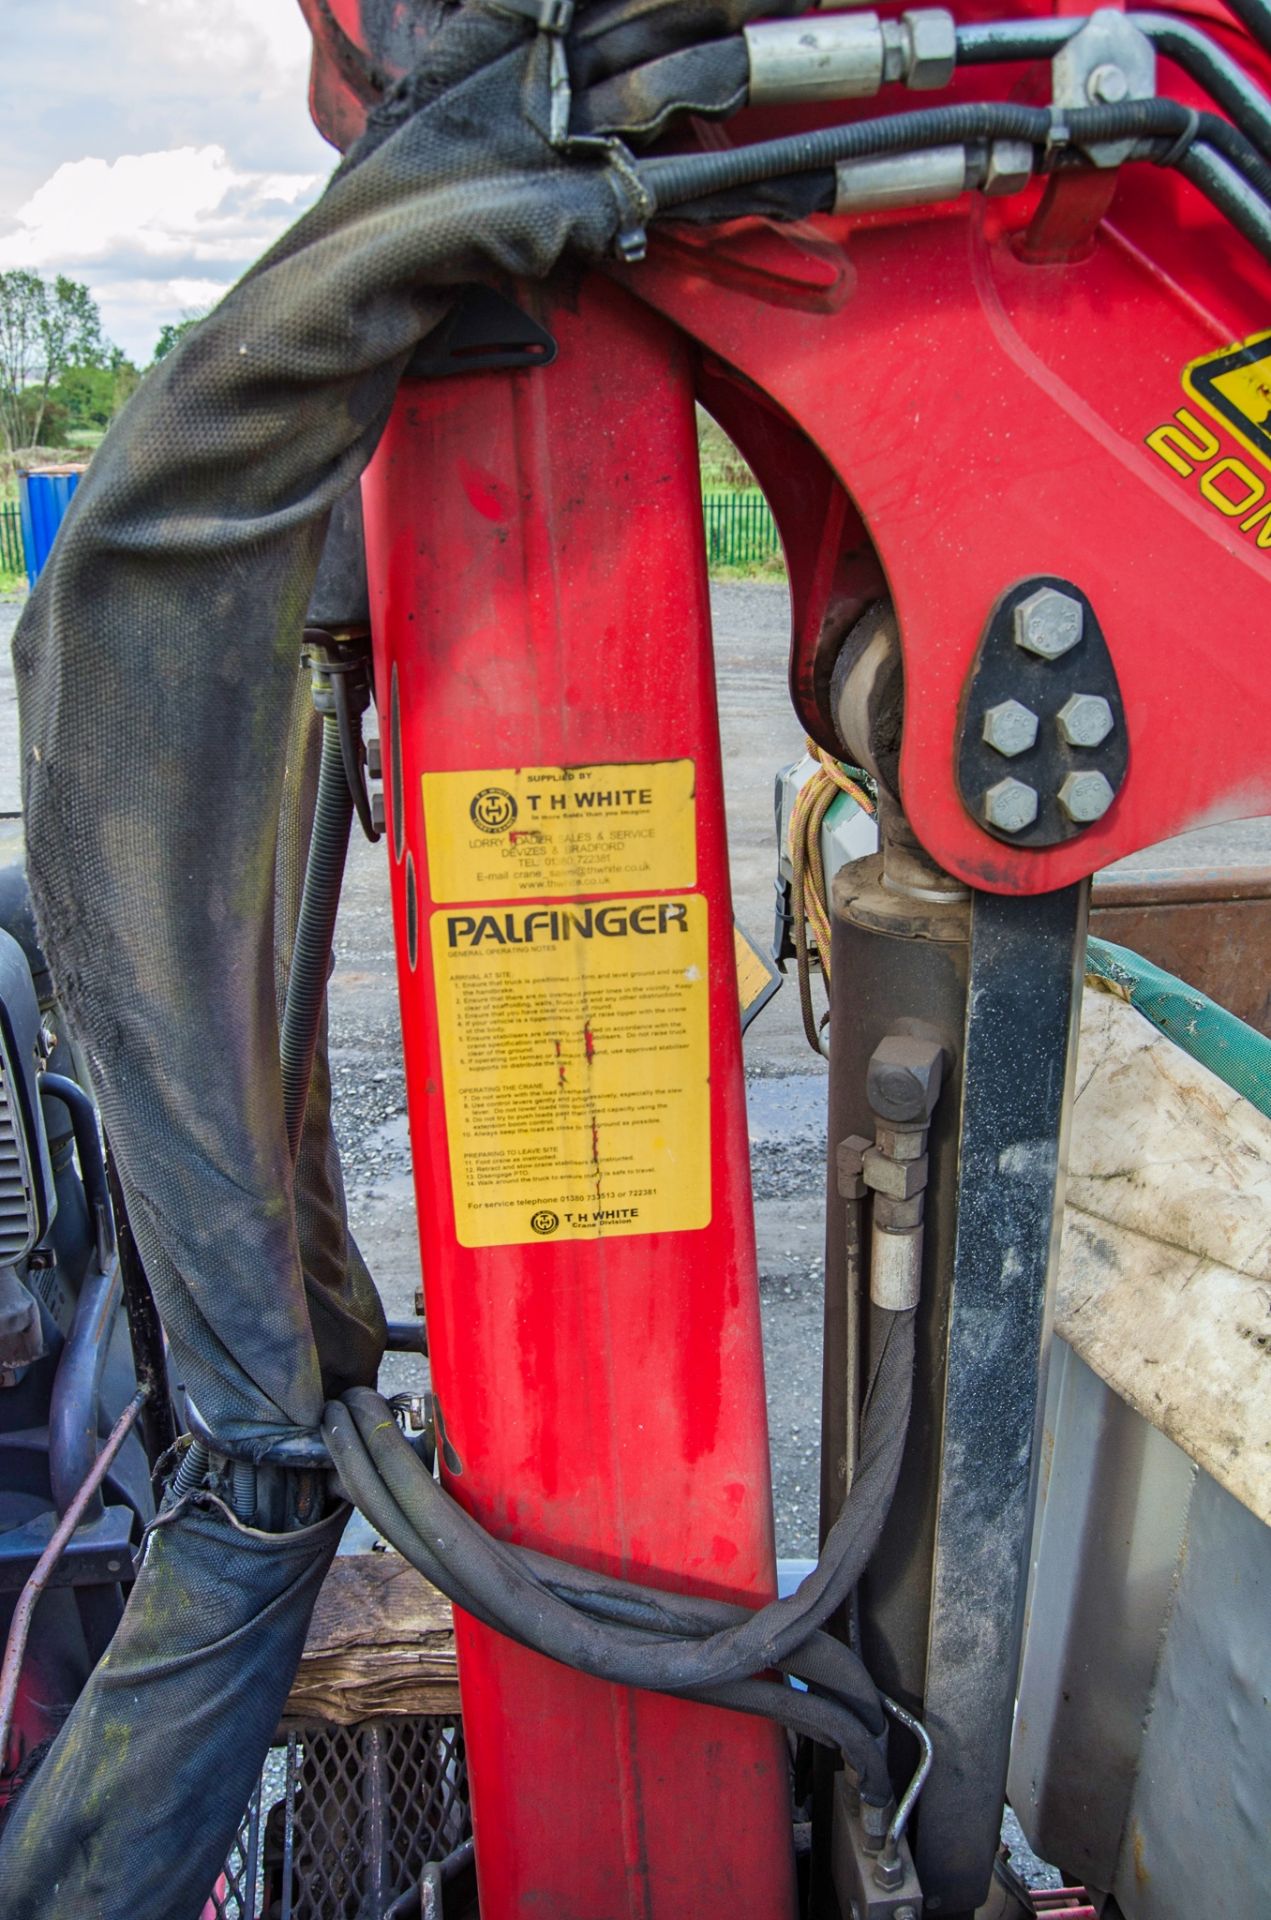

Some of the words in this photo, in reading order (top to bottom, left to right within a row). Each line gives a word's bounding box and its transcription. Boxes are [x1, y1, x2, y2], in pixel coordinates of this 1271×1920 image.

[579, 772, 592, 780] BY
[526, 795, 541, 811] T
[550, 794, 566, 810] H
[574, 788, 653, 808] WHITE
[469, 838, 504, 849] LORRY
[510, 834, 553, 847] OADER
[559, 832, 592, 842] ALES
[609, 828, 655, 840] SERVICE
[501, 847, 546, 858] DEVIZES
[447, 903, 689, 948] PALFINGER
[448, 950, 483, 958] GENERAL
[531, 945, 557, 953] NOTES
[484, 1199, 515, 1207] service
[516, 1196, 558, 1206] telephone
[560, 1194, 584, 1202] 01380
[628, 1189, 657, 1197] 722381
[564, 1214, 573, 1222] T
[578, 1213, 588, 1222] H
[593, 1208, 639, 1221] WHITE
[600, 1219, 632, 1227] Division
